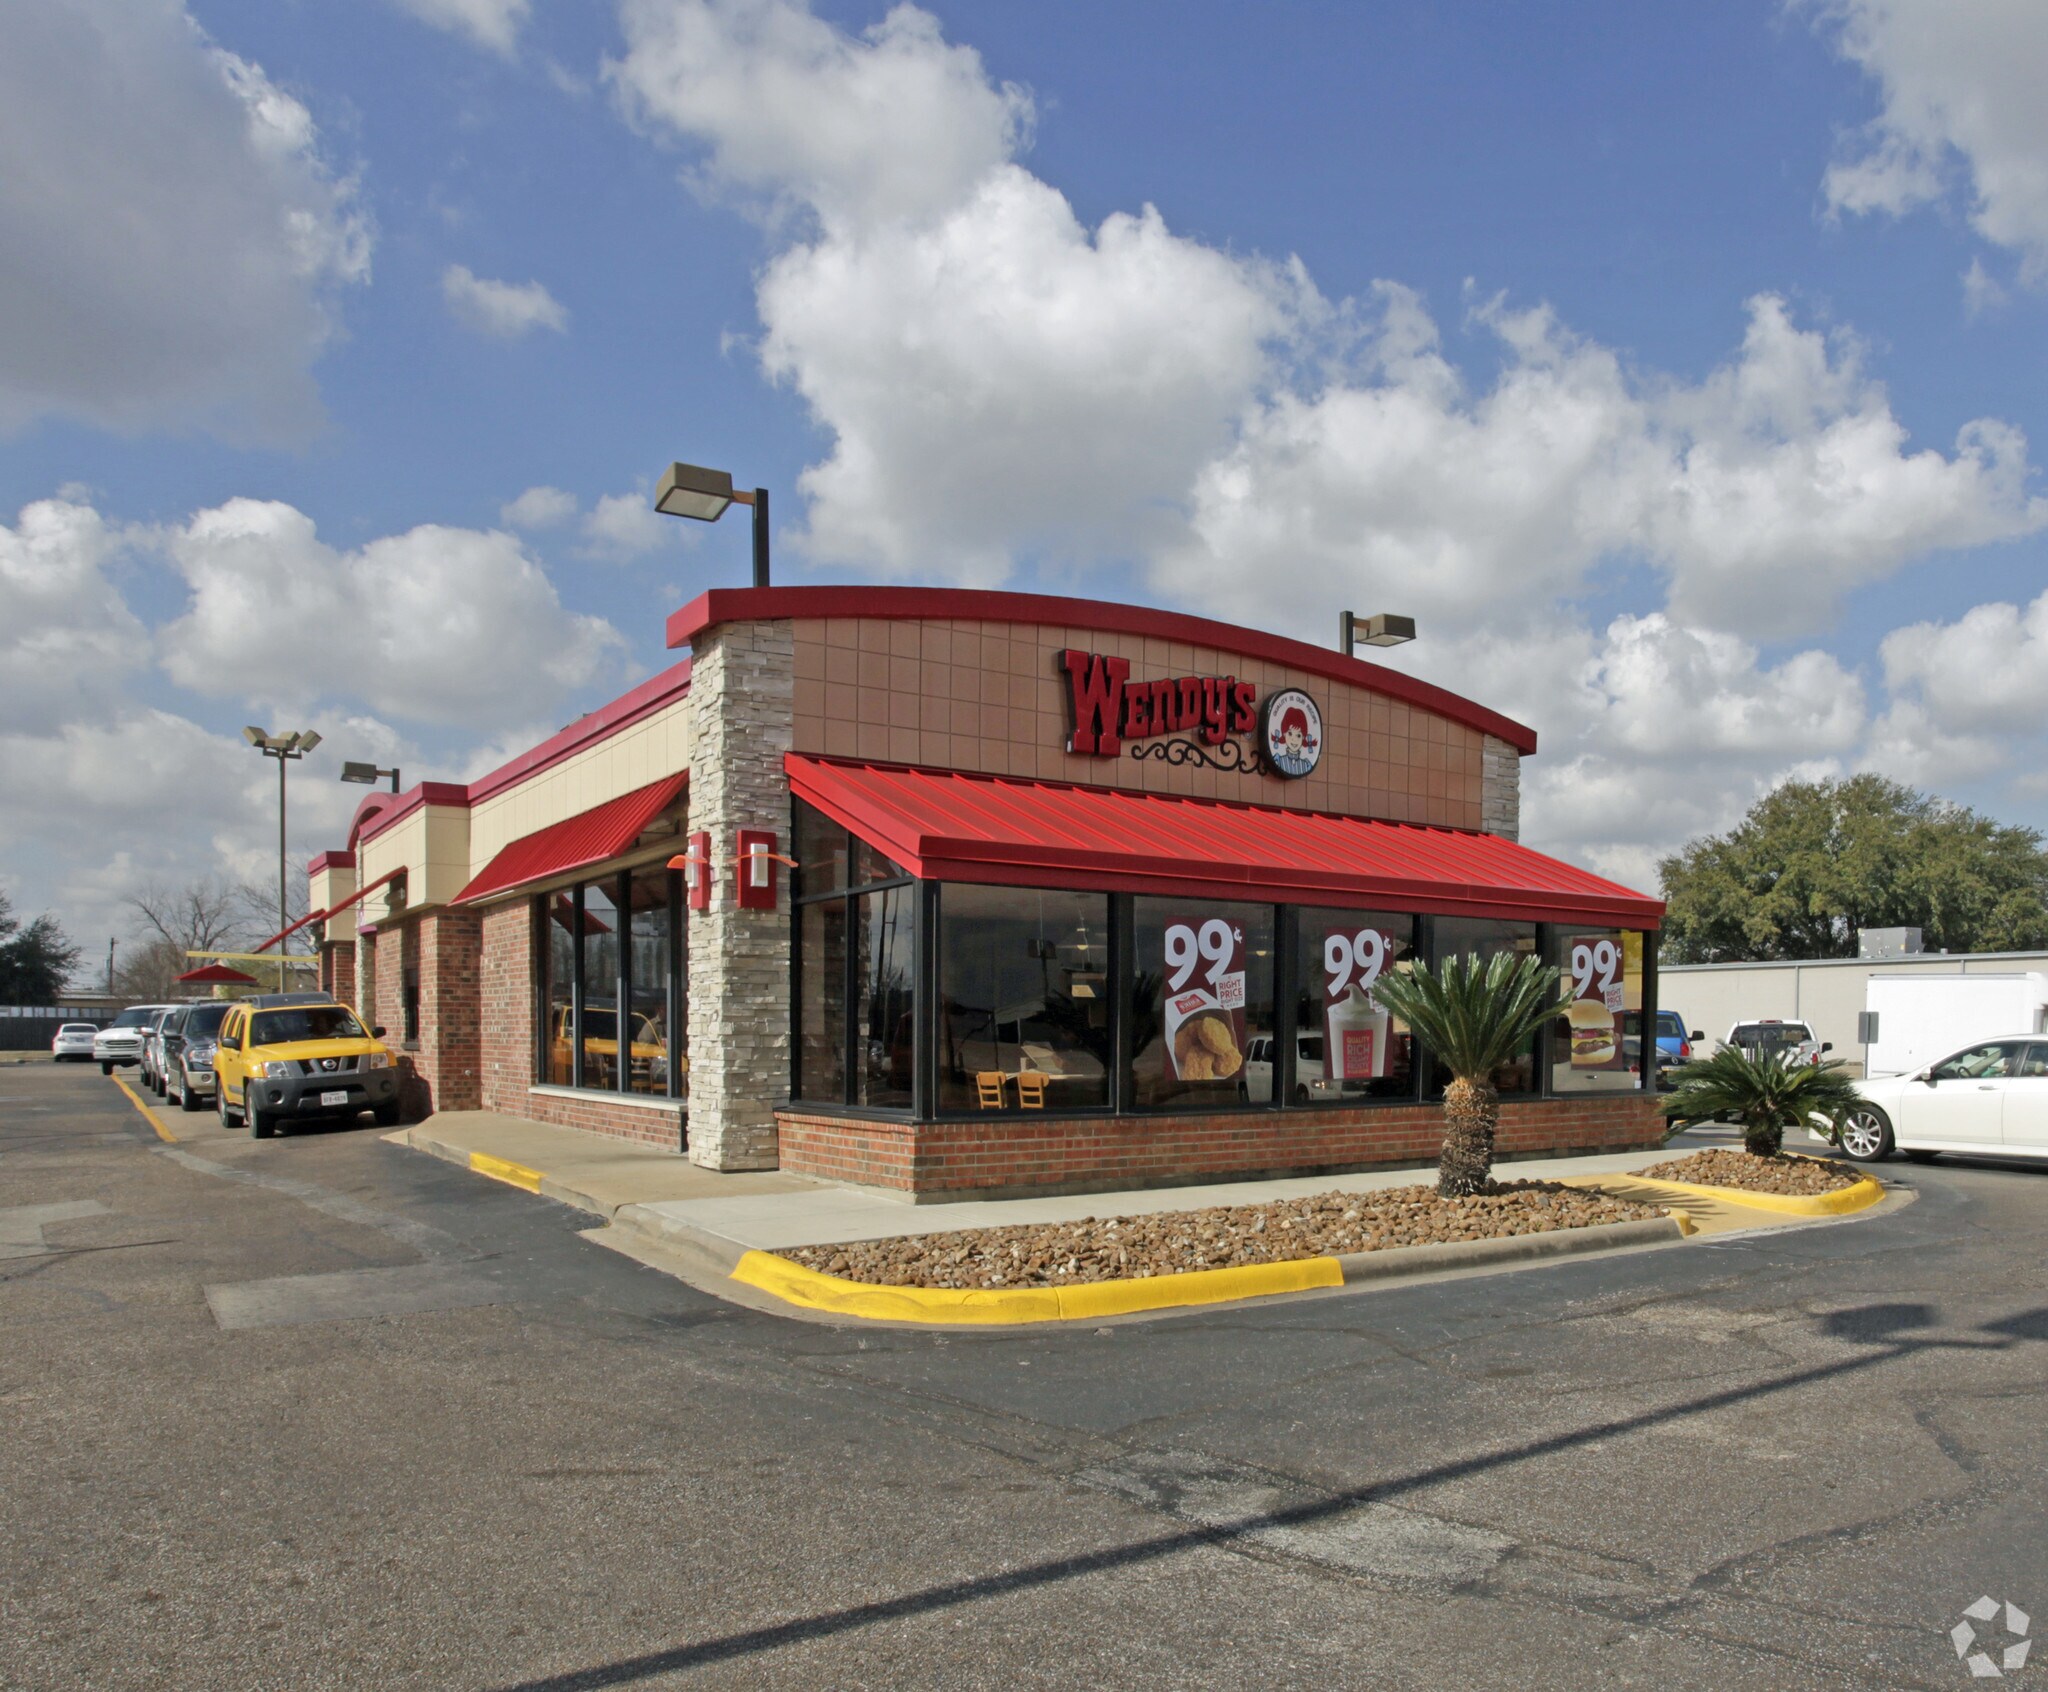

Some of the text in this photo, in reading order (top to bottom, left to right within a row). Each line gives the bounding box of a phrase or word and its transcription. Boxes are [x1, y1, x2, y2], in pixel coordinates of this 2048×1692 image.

[1296, 696, 1306, 705] OUR
[1219, 979, 1242, 990] RIGHT
[1220, 988, 1242, 999] PRICE
[1347, 1044, 1370, 1055] RICH
